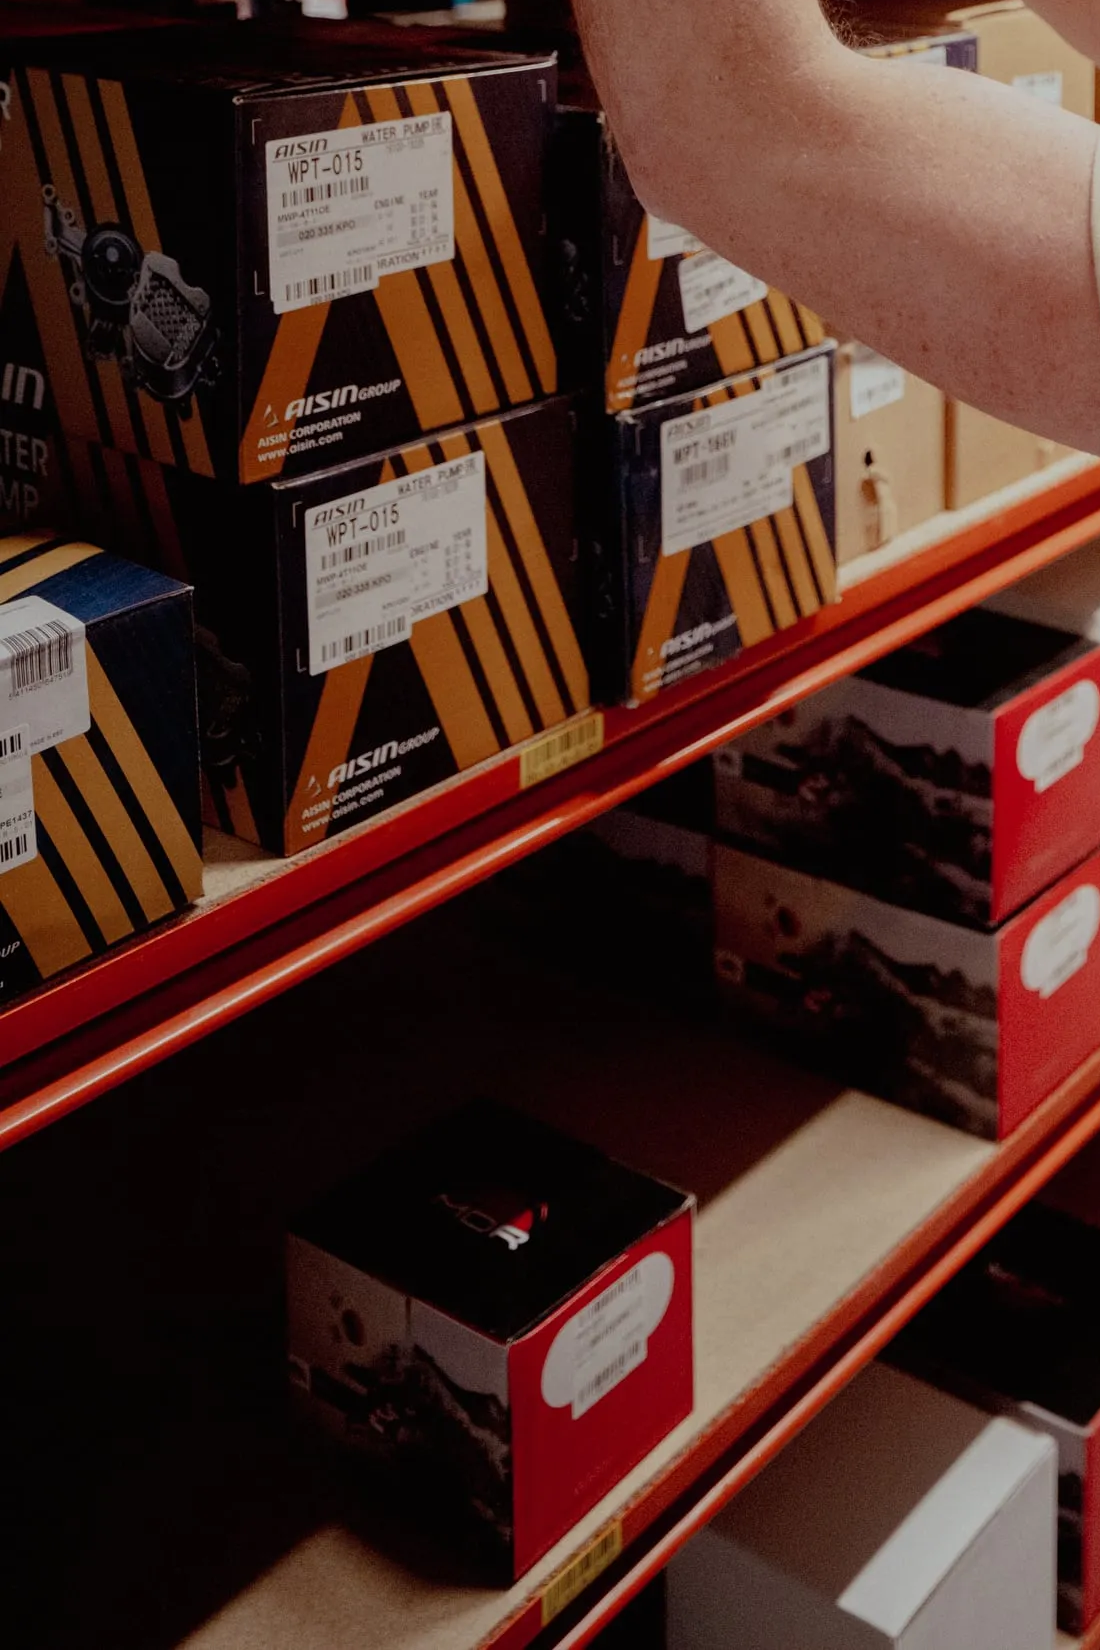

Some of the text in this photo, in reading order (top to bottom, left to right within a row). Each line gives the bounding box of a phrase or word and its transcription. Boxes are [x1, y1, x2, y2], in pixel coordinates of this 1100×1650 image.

[274, 120, 429, 160] AISIN WATER PUMP
[288, 150, 363, 184] WPT-015
[298, 228, 316, 241] 020
[336, 220, 356, 232] KPO
[377, 251, 420, 269] RATION
[284, 379, 401, 421] AISIN GROUP
[258, 411, 362, 449] AISIN CORPORATION
[258, 431, 344, 463] www.aisin.com
[0, 428, 48, 476] TER
[314, 498, 365, 526] AISIN
[398, 475, 431, 494] WATER
[326, 503, 400, 548] WPT-015
[327, 726, 440, 789] AISIN GROUP
[302, 766, 401, 820] AISIN CORPORATION
[302, 789, 384, 832] www.aisin.com
[0, 810, 33, 829] PE1437
